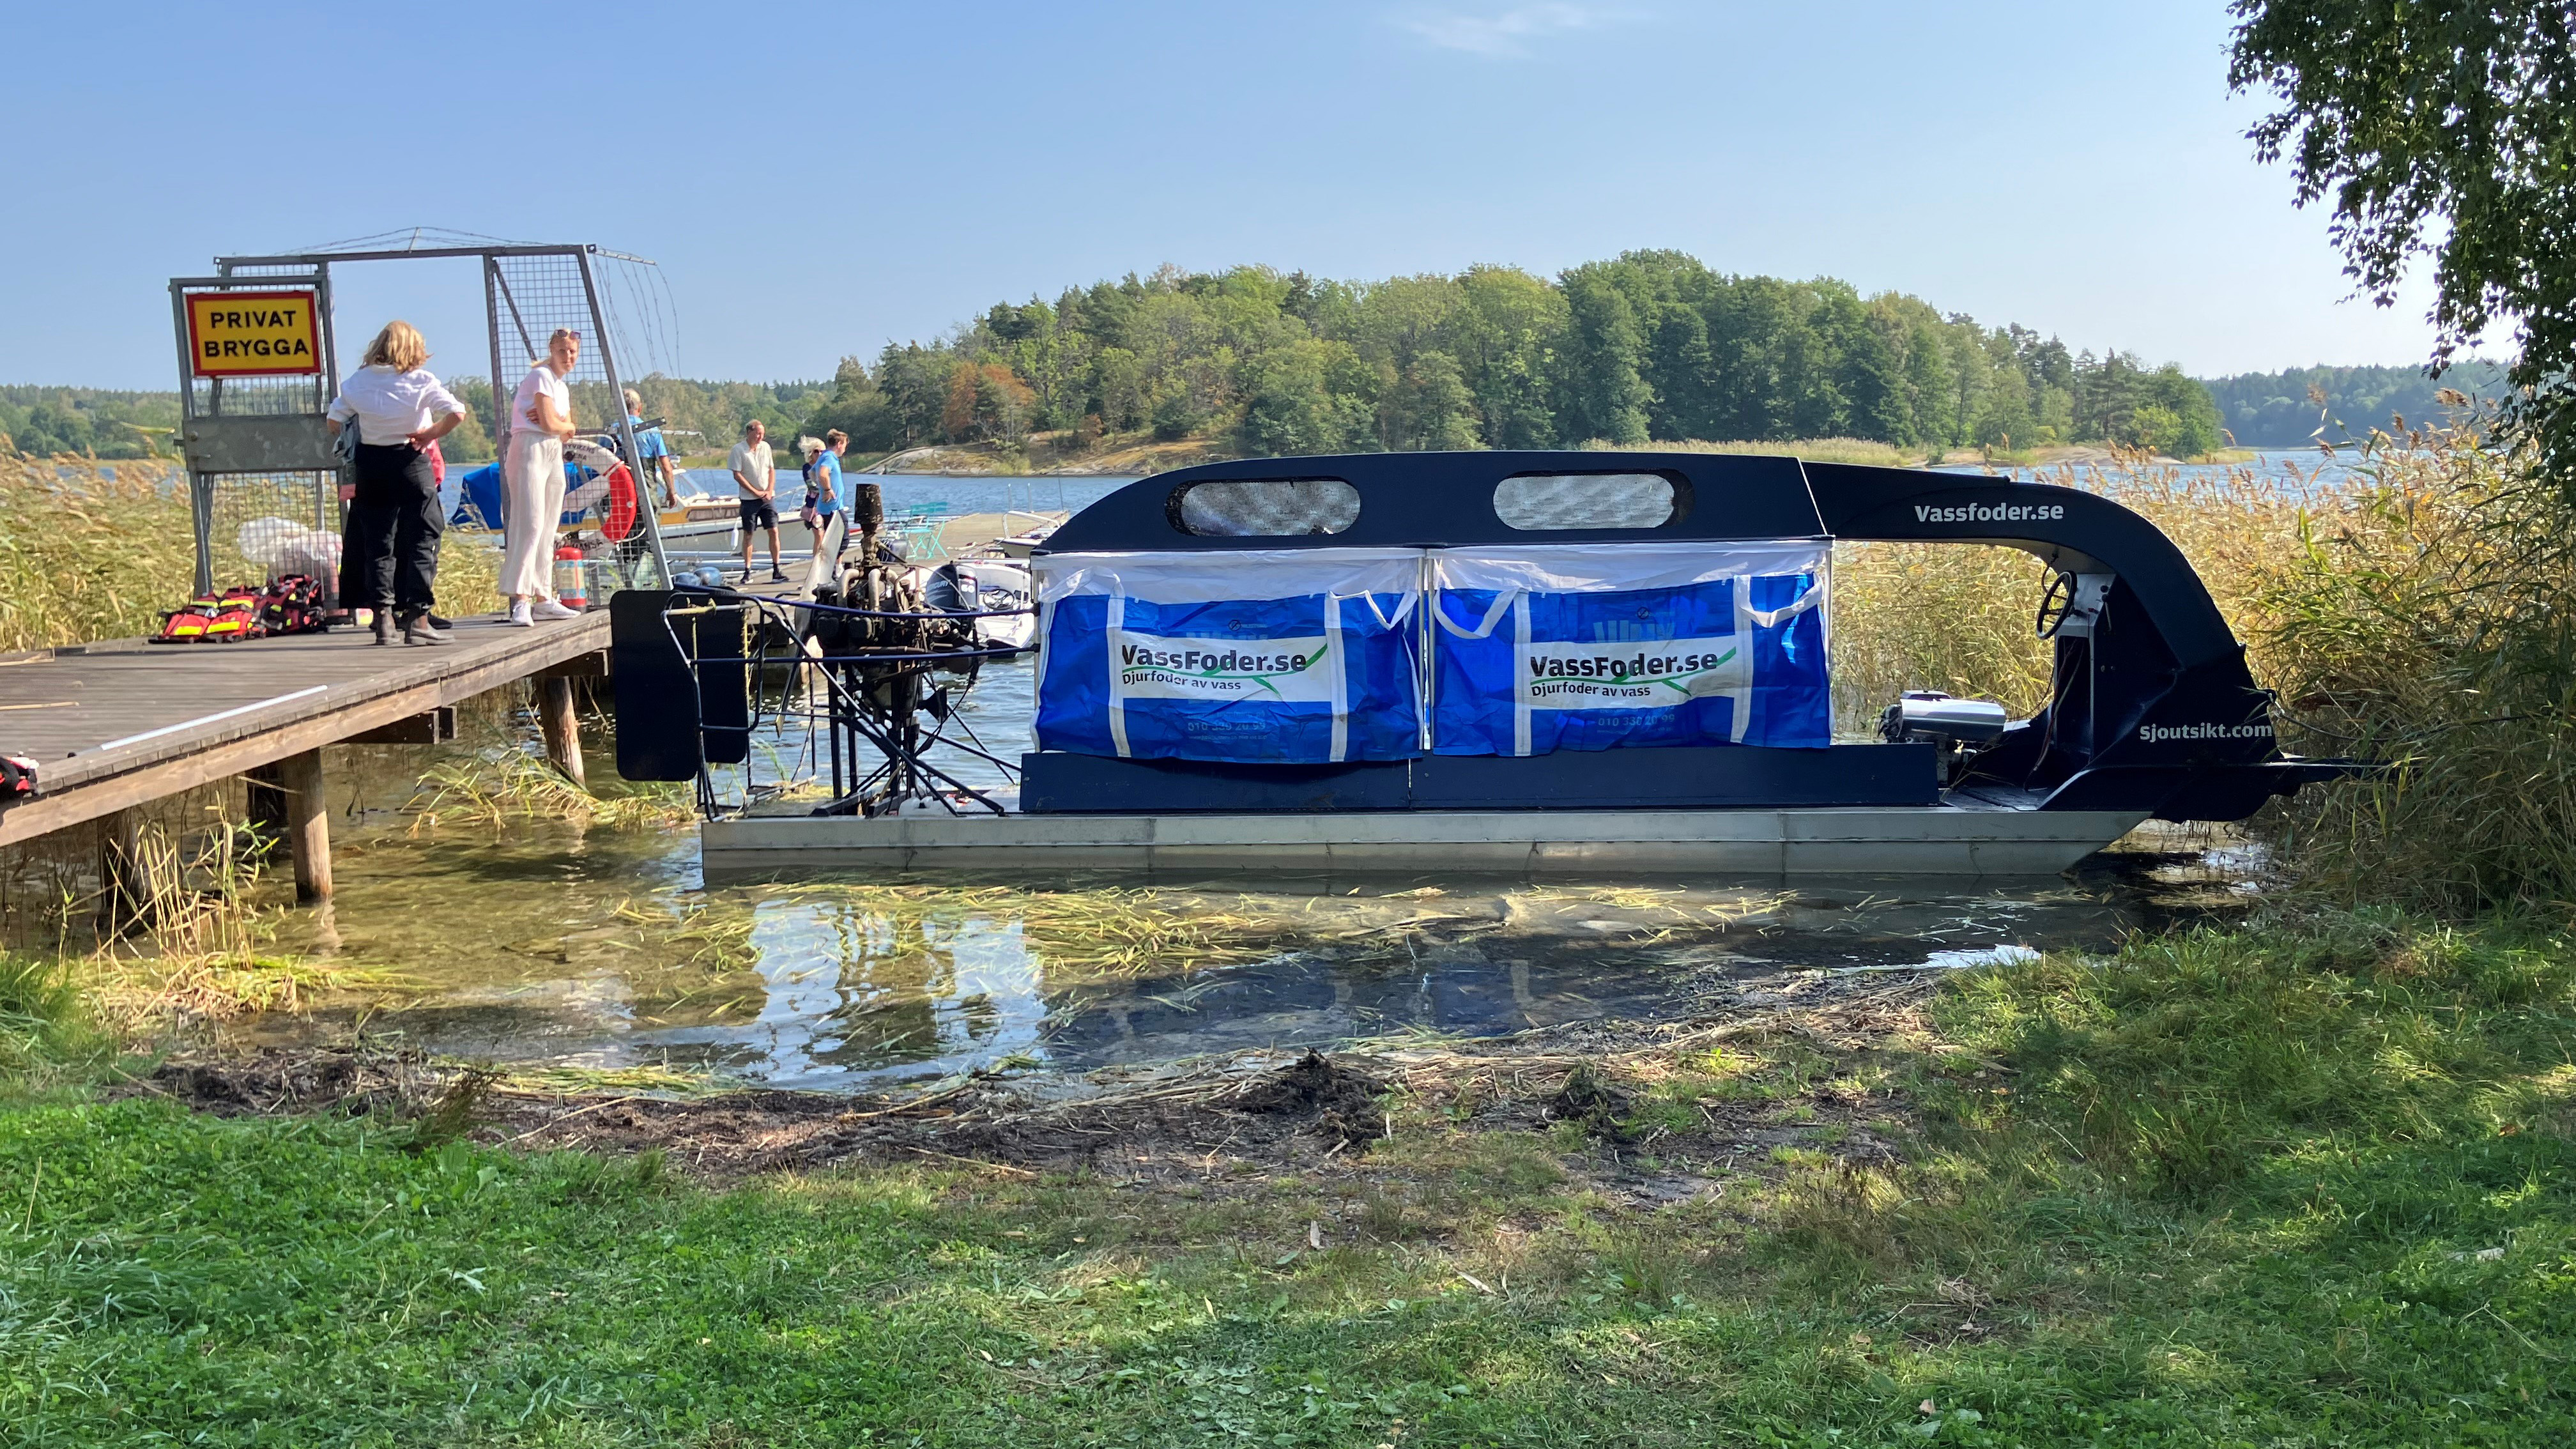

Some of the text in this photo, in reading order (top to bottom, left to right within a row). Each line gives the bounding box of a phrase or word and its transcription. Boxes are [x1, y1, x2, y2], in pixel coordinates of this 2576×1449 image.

[210, 310, 296, 328] PRIVAT
[204, 339, 309, 357] BRYGGA
[1914, 502, 2064, 522] Vassfoder.se
[1122, 645, 1307, 671] VassFoder.se
[1530, 653, 1718, 677] VassFoder.se
[1123, 670, 1241, 690] Djurfoder av vass
[1531, 682, 1651, 698] Djurfoder av vass
[1598, 717, 1620, 726] 010
